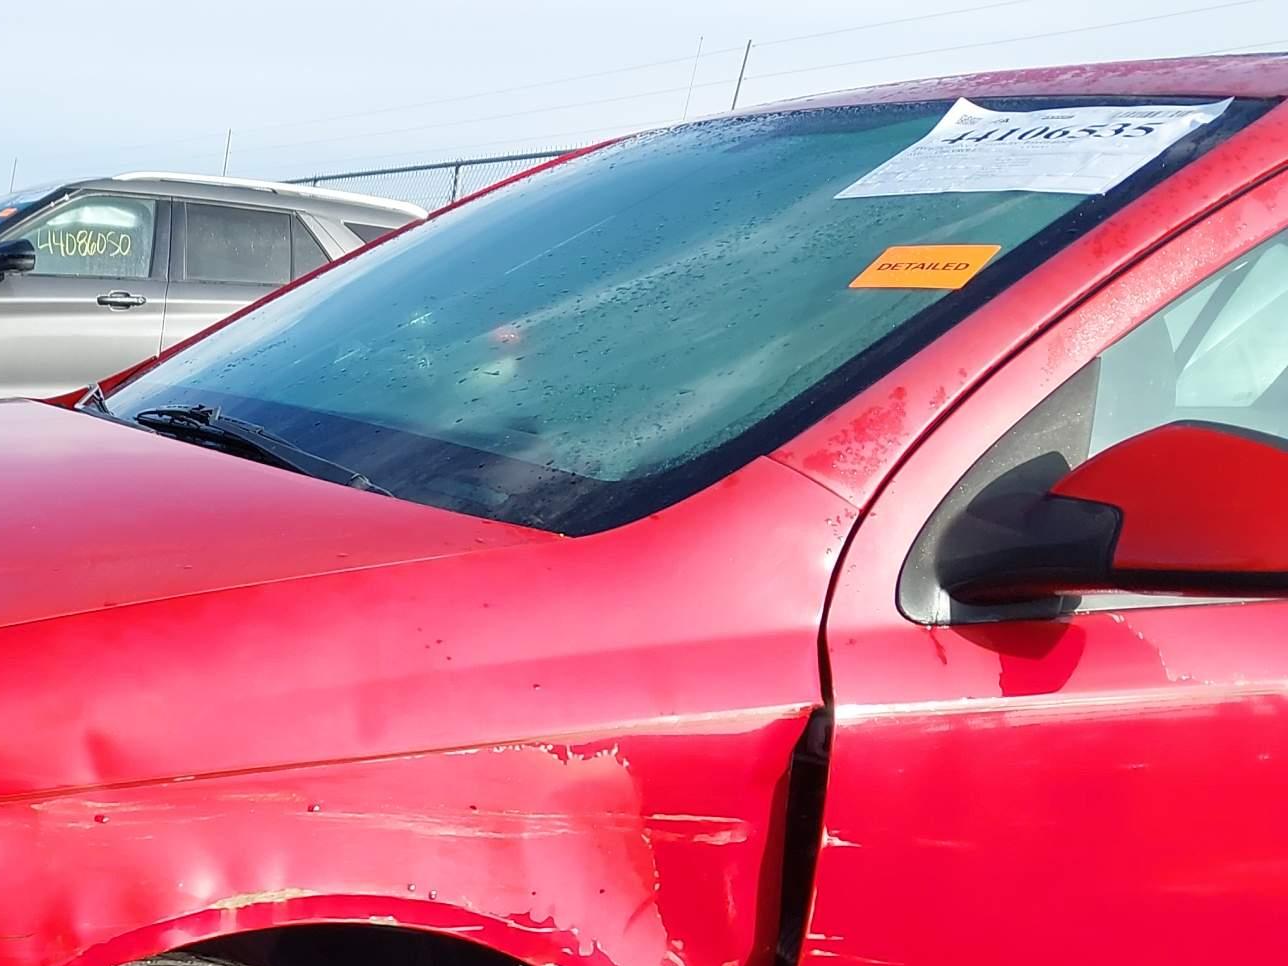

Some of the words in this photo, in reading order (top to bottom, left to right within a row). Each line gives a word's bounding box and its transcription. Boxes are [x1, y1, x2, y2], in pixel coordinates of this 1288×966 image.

[942, 122, 1163, 144] 44106535
[37, 229, 131, 257] 44086050
[877, 262, 970, 271] DETAILED
